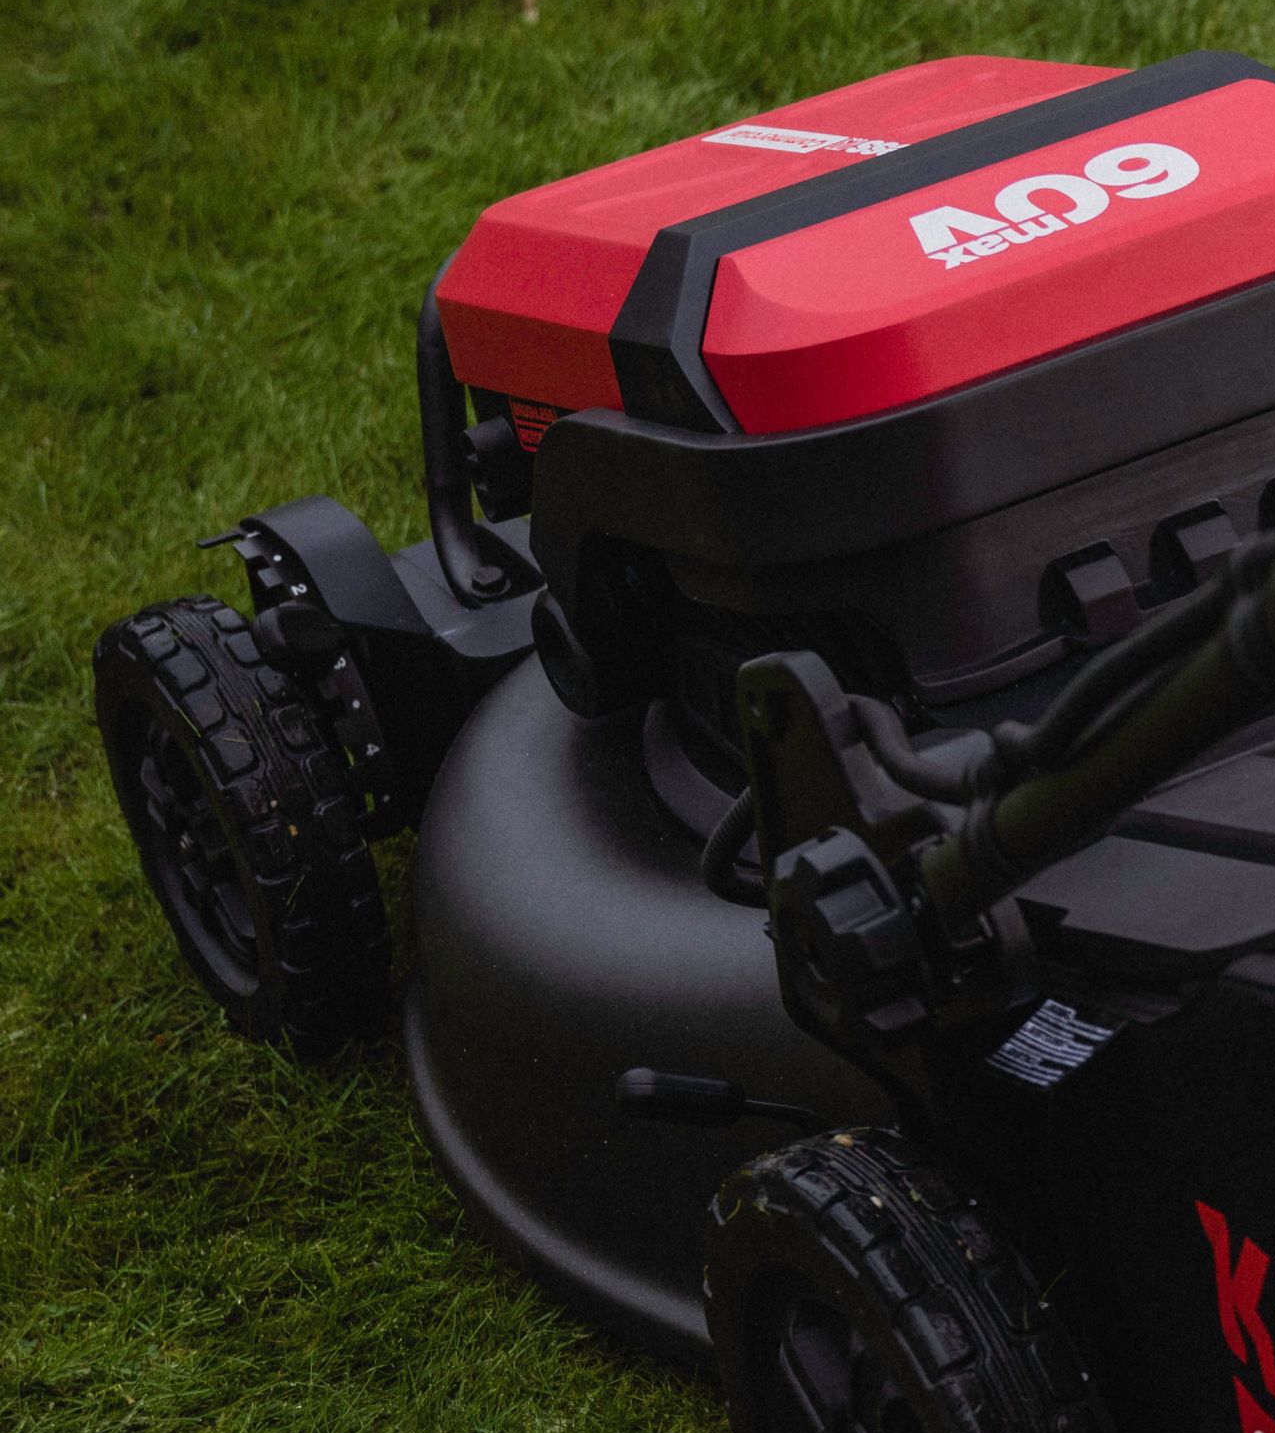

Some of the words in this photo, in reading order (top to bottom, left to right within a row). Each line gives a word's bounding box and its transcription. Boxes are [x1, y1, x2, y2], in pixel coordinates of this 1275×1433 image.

[927, 213, 1069, 270] max
[290, 583, 308, 597] 2
[366, 743, 381, 757] 4
